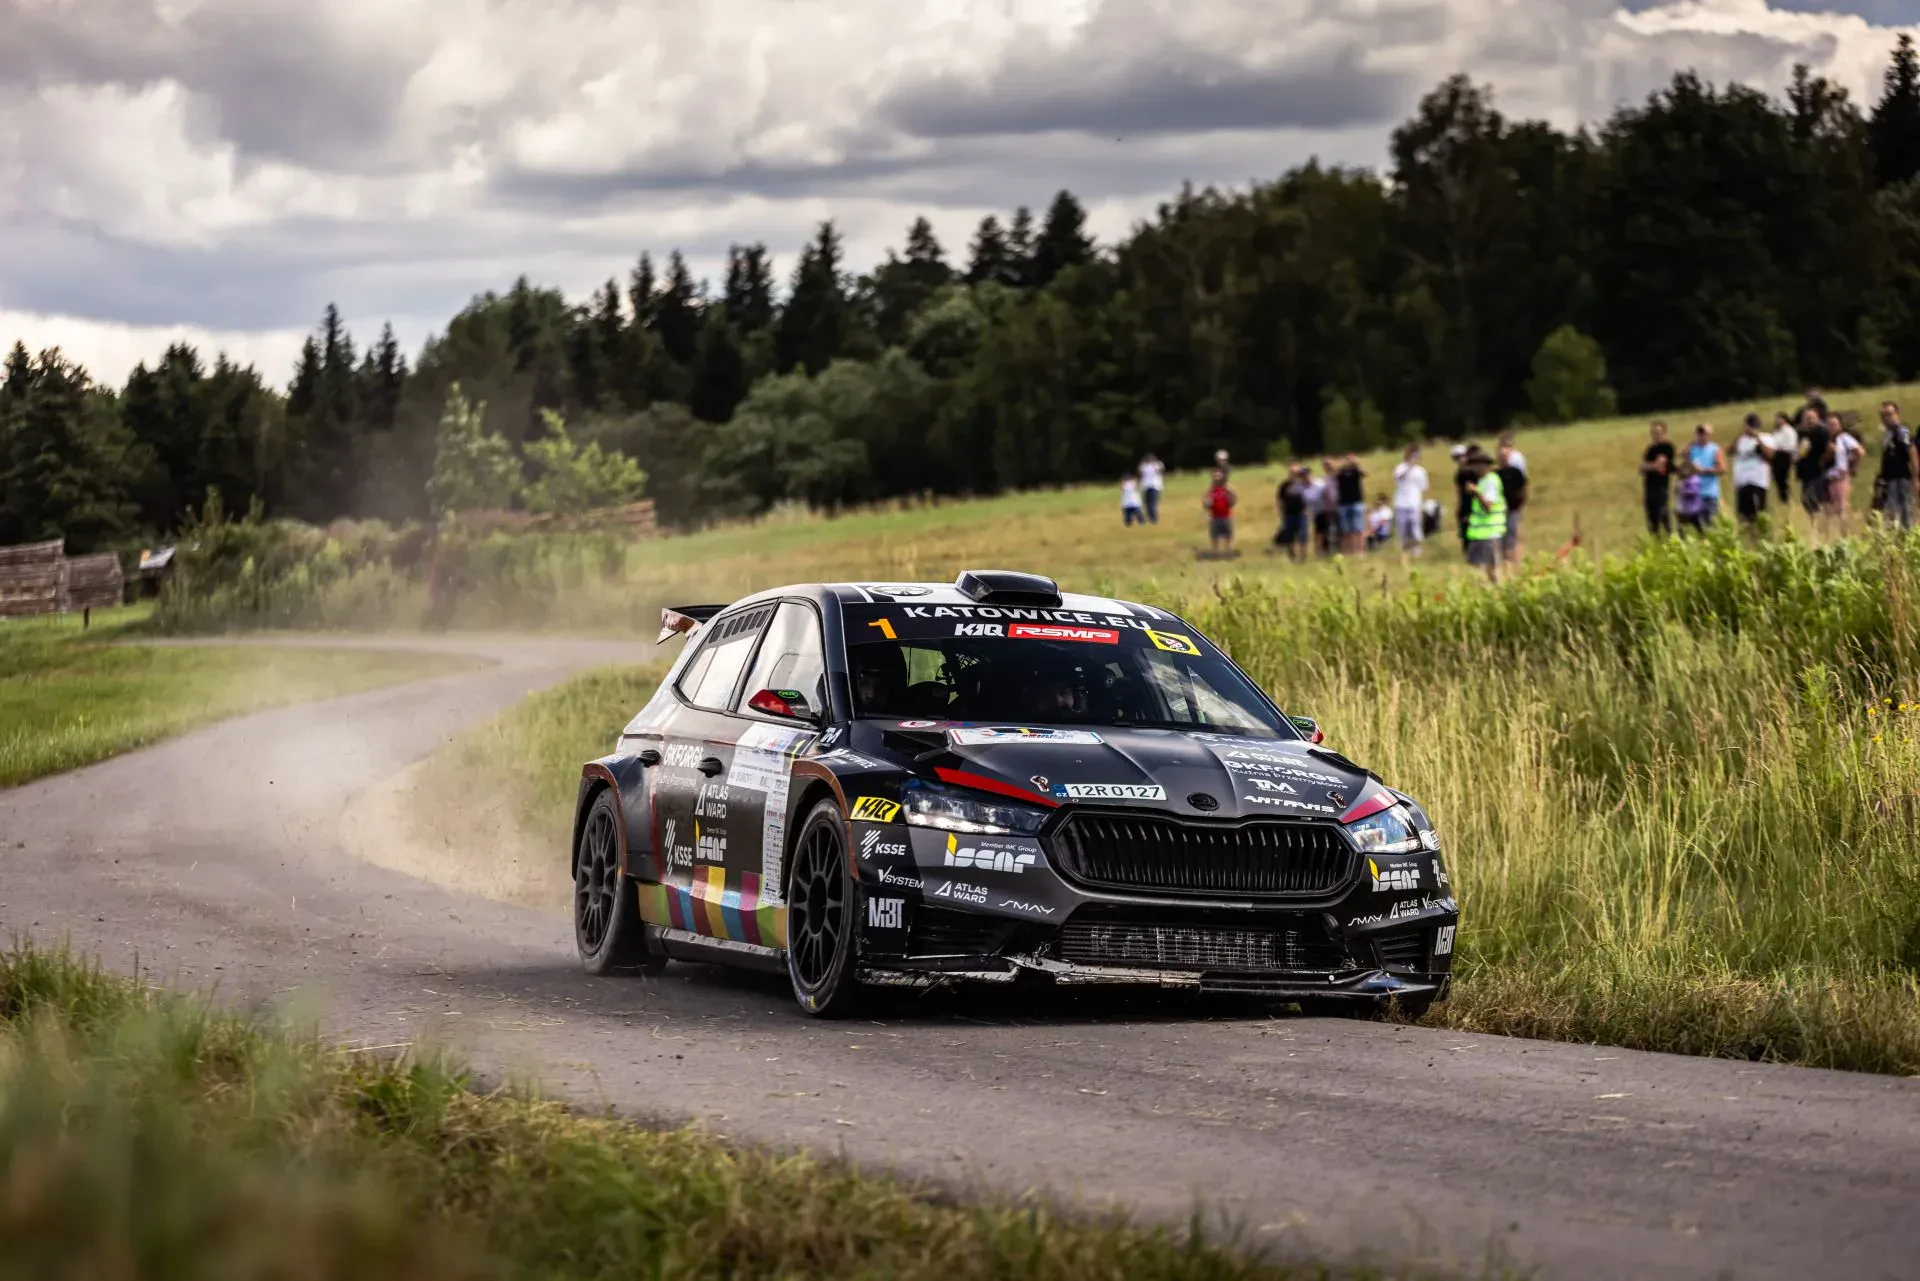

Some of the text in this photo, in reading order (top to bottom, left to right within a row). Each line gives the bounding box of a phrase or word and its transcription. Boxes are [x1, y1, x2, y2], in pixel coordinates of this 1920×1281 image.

[903, 606, 1152, 630] KATOWICE.EU
[868, 618, 898, 640] 1
[1015, 626, 1112, 639] RSMP
[706, 784, 729, 801] ATLAS
[1071, 785, 1160, 798] 12R 0127
[705, 802, 727, 819] WARD
[875, 842, 907, 856] KSSE
[981, 841, 1004, 849] Member
[1018, 845, 1037, 854] Group
[674, 845, 693, 868] KSSE
[954, 882, 988, 895] ATLAS
[953, 891, 987, 904] WARD
[1400, 899, 1418, 909] ATLAS
[1399, 908, 1420, 918] WARD
